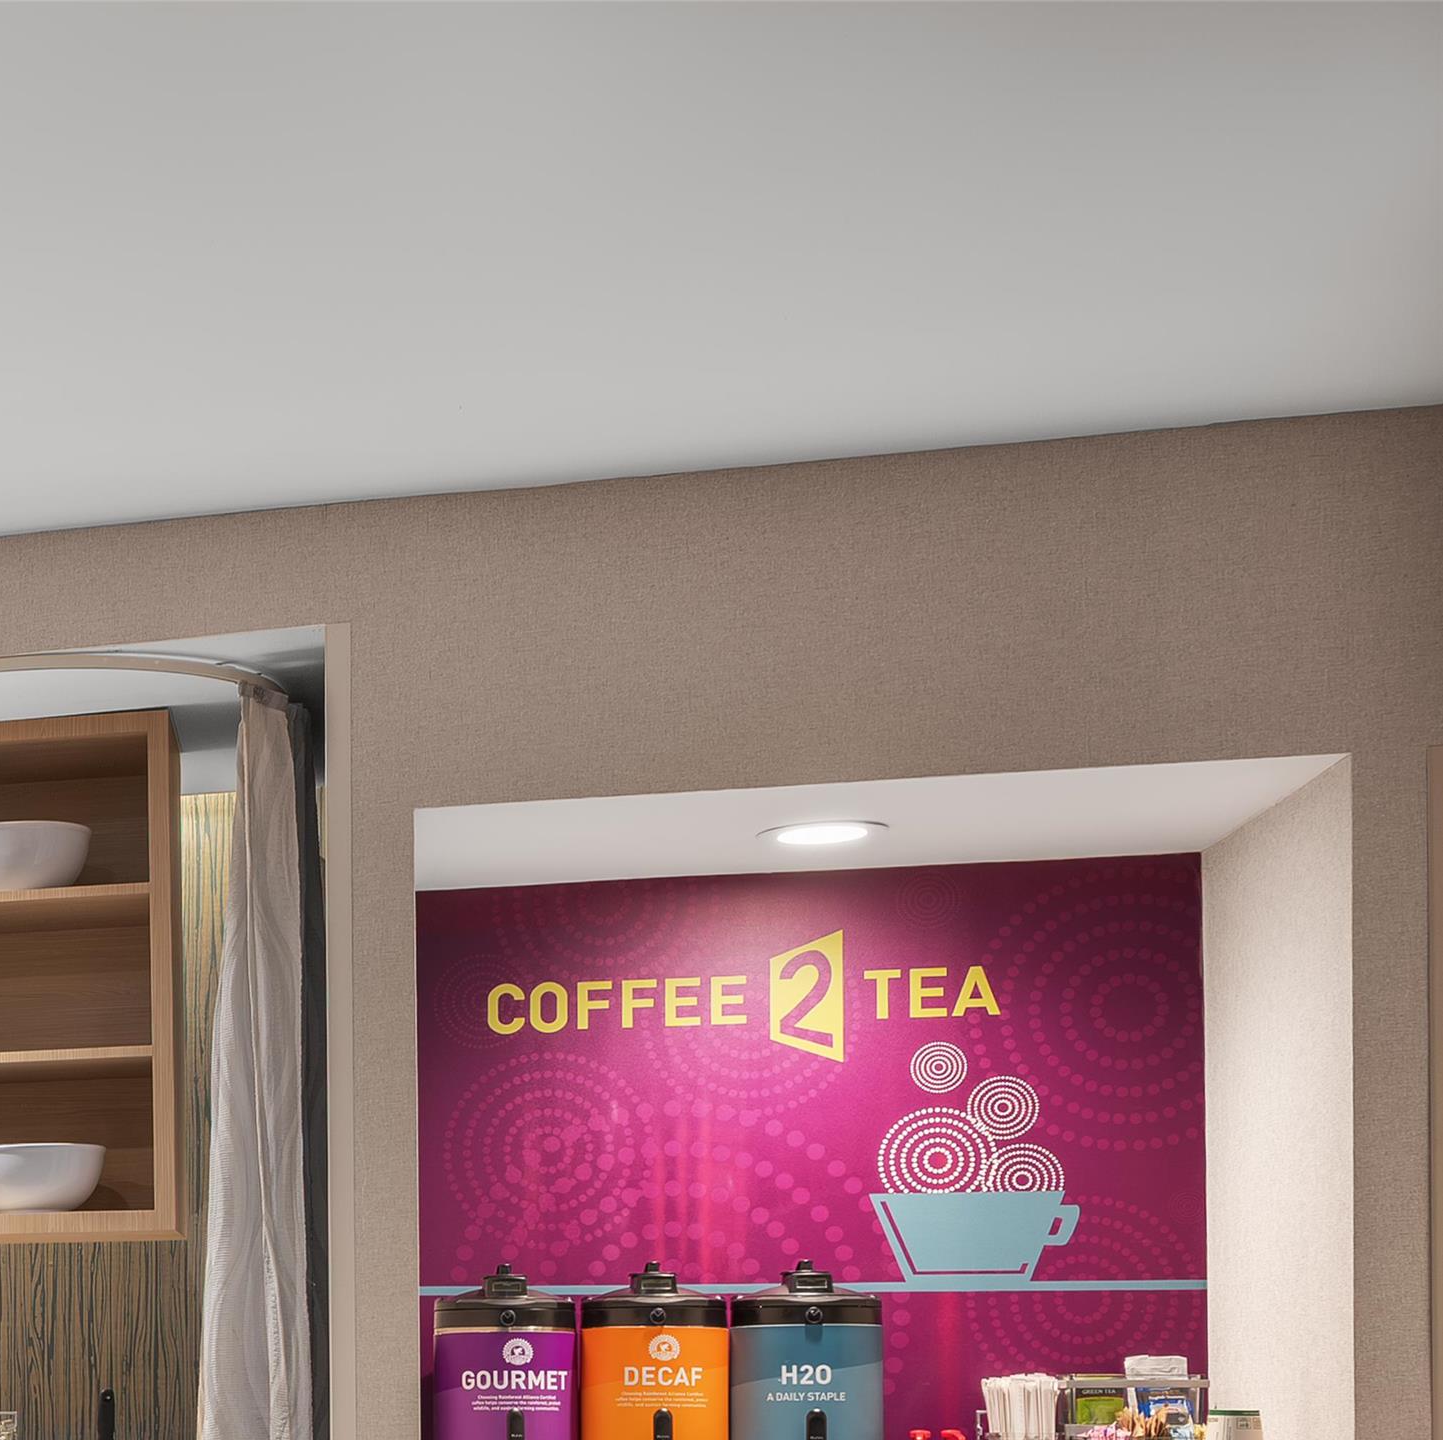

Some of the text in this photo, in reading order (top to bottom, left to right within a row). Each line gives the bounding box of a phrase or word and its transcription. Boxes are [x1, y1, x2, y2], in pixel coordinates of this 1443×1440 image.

[486, 948, 1002, 1049] COFFEE 2 TEA
[461, 1370, 568, 1391] GOURMET
[623, 1366, 704, 1387] DECAF
[766, 1391, 847, 1402] A DAILY STAPLE
